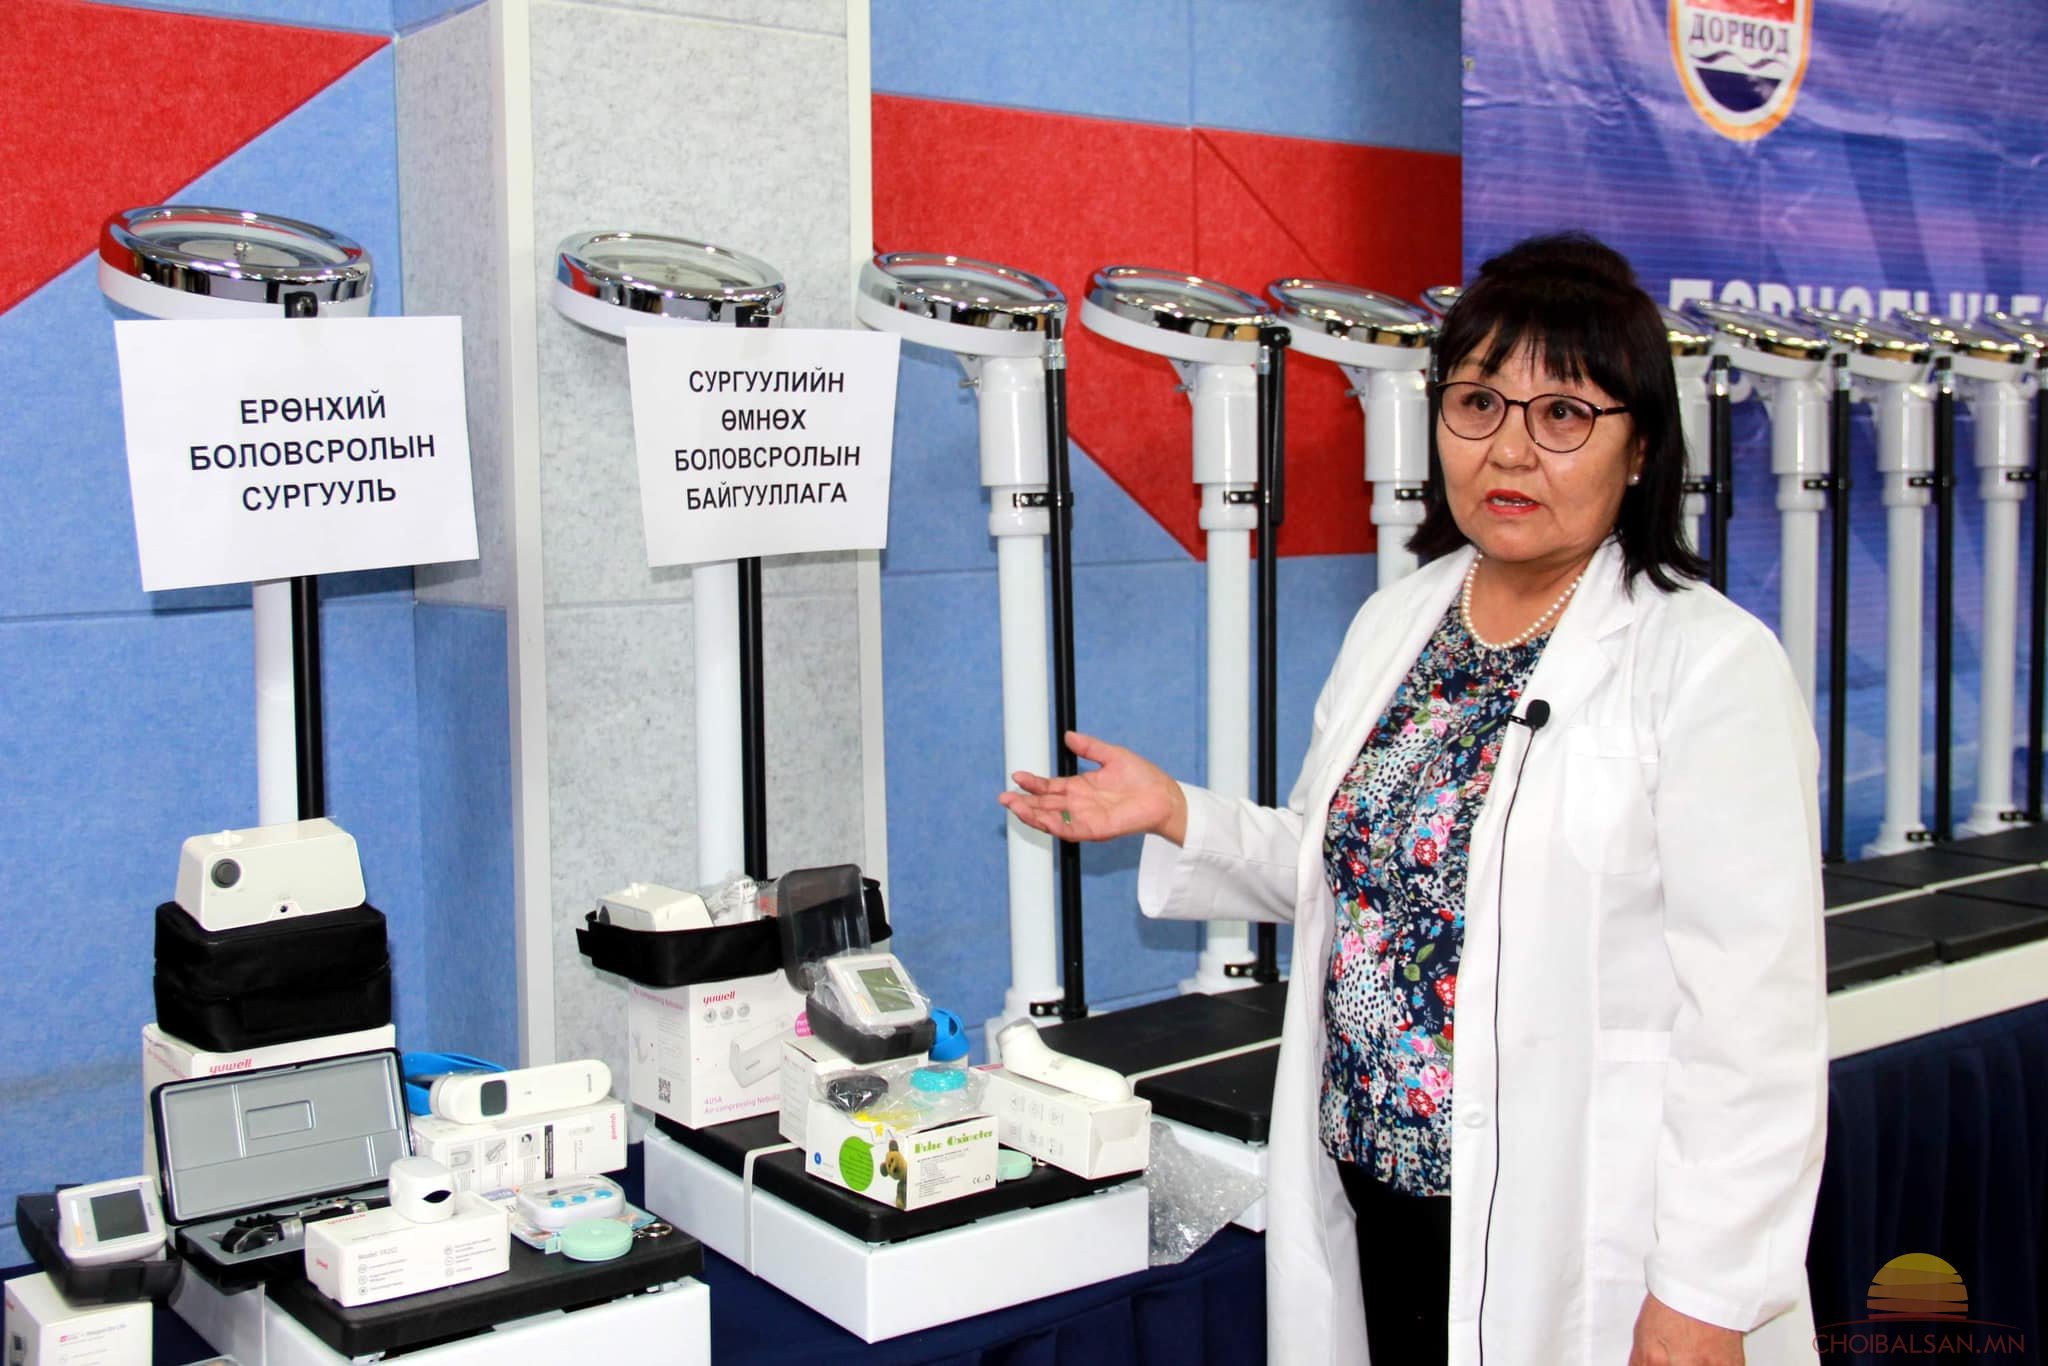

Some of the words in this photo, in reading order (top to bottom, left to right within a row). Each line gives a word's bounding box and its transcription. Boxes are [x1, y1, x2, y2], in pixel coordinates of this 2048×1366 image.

[1690, 13, 1789, 54] ДОРНОД
[688, 366, 845, 393] СУРГУУЛИЙН
[239, 389, 387, 425] ЕРӨНХИЙ
[720, 408, 807, 431] ӨМНӨХ
[189, 434, 436, 472] БОЛОВСРОЛЫН
[674, 445, 861, 472] БОЛОВСРОЛЫН
[241, 478, 397, 512] СУРГУУЛЬ
[686, 480, 848, 511] БАЙГУУЛЛАГА
[703, 991, 736, 1005] yuwell
[209, 1059, 253, 1074] yuwell
